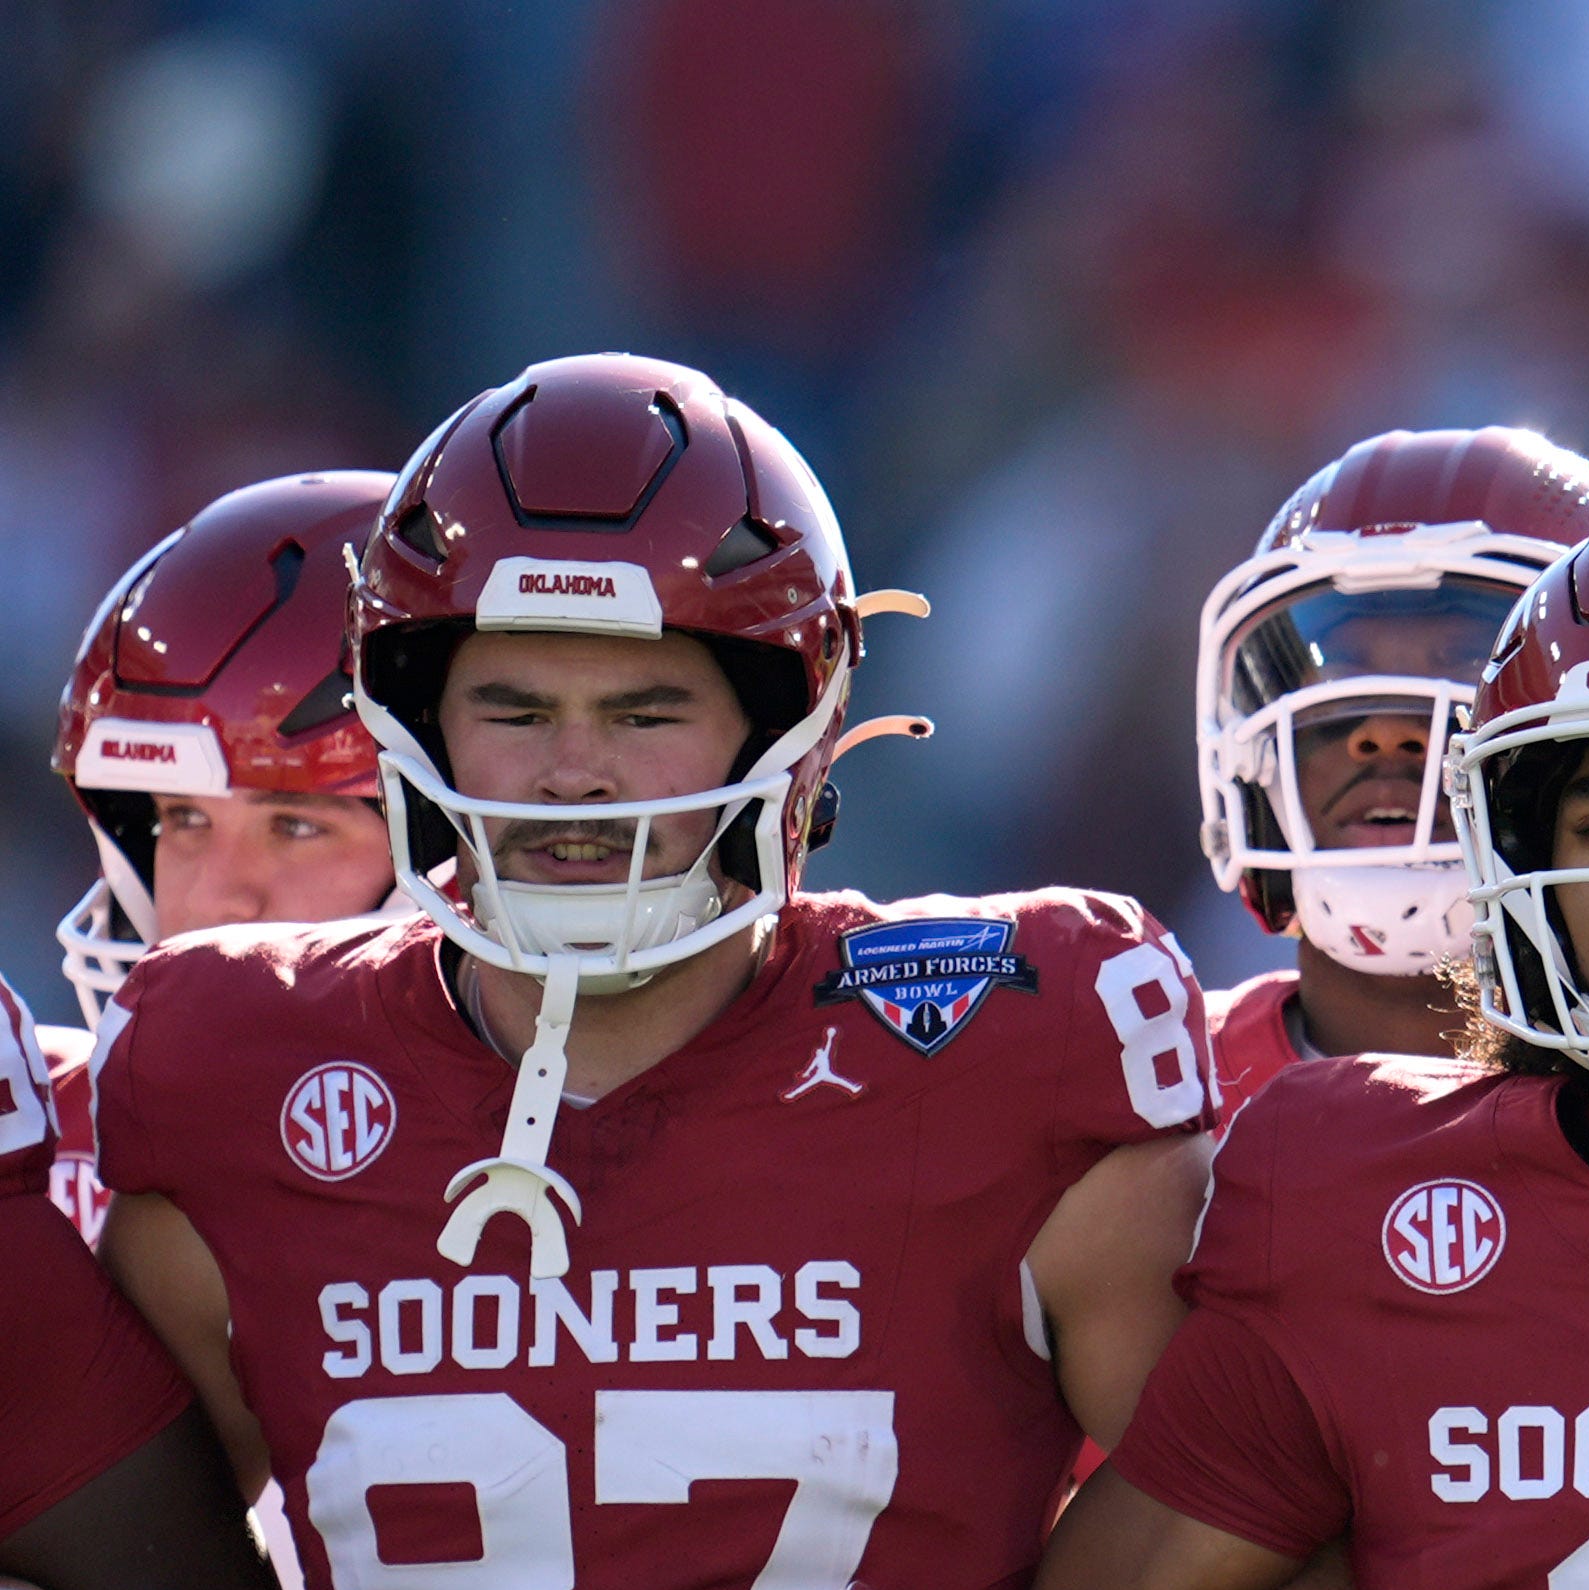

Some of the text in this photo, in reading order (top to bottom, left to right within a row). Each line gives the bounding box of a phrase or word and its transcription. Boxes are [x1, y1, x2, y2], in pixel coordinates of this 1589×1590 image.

[518, 574, 616, 598] OKLAHOMA
[837, 955, 1016, 990] ARMED FORCES
[895, 982, 958, 1001] BOWL
[290, 1070, 385, 1171] SEC
[1393, 1186, 1494, 1285] SEC
[317, 1260, 861, 1379] SOONERS
